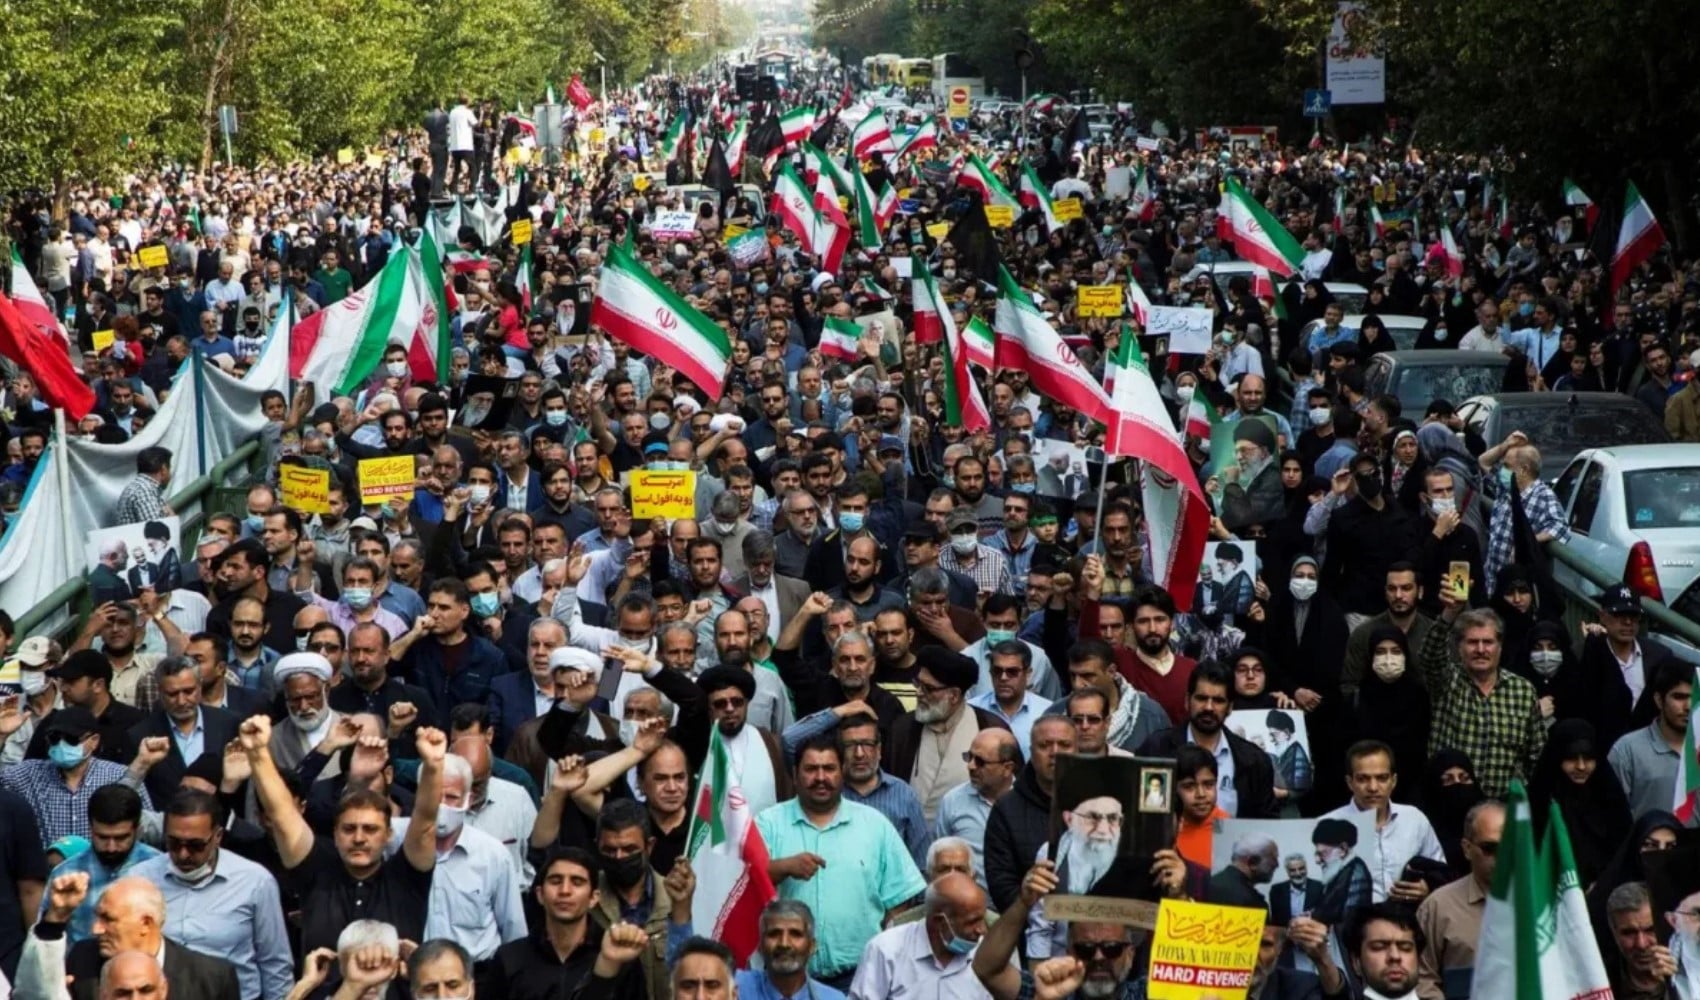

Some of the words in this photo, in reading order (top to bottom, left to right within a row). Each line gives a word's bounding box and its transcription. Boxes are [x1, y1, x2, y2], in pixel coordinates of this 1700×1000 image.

[1156, 943, 1196, 963] DOWN
[1201, 948, 1232, 967] WITH
[1153, 963, 1195, 983] HARD
[1196, 968, 1252, 988] REVENGE
